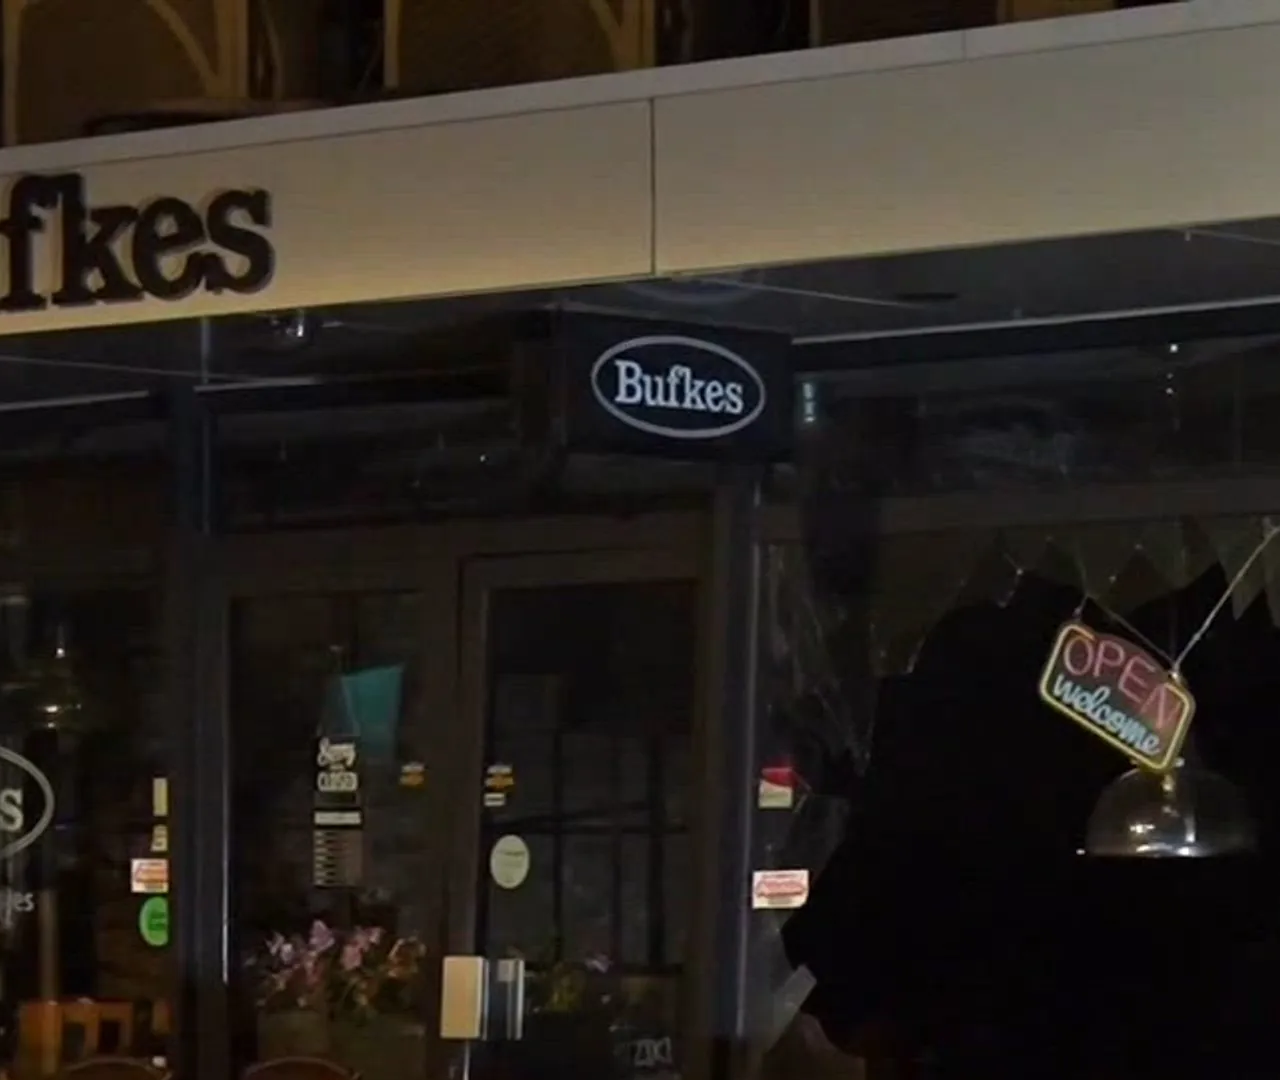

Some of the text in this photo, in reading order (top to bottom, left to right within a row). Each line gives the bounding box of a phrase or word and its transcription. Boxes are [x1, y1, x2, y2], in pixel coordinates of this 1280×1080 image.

[613, 359, 745, 415] Bufkes
[1053, 673, 1161, 756] welcome
[1063, 634, 1182, 730] OPEN
